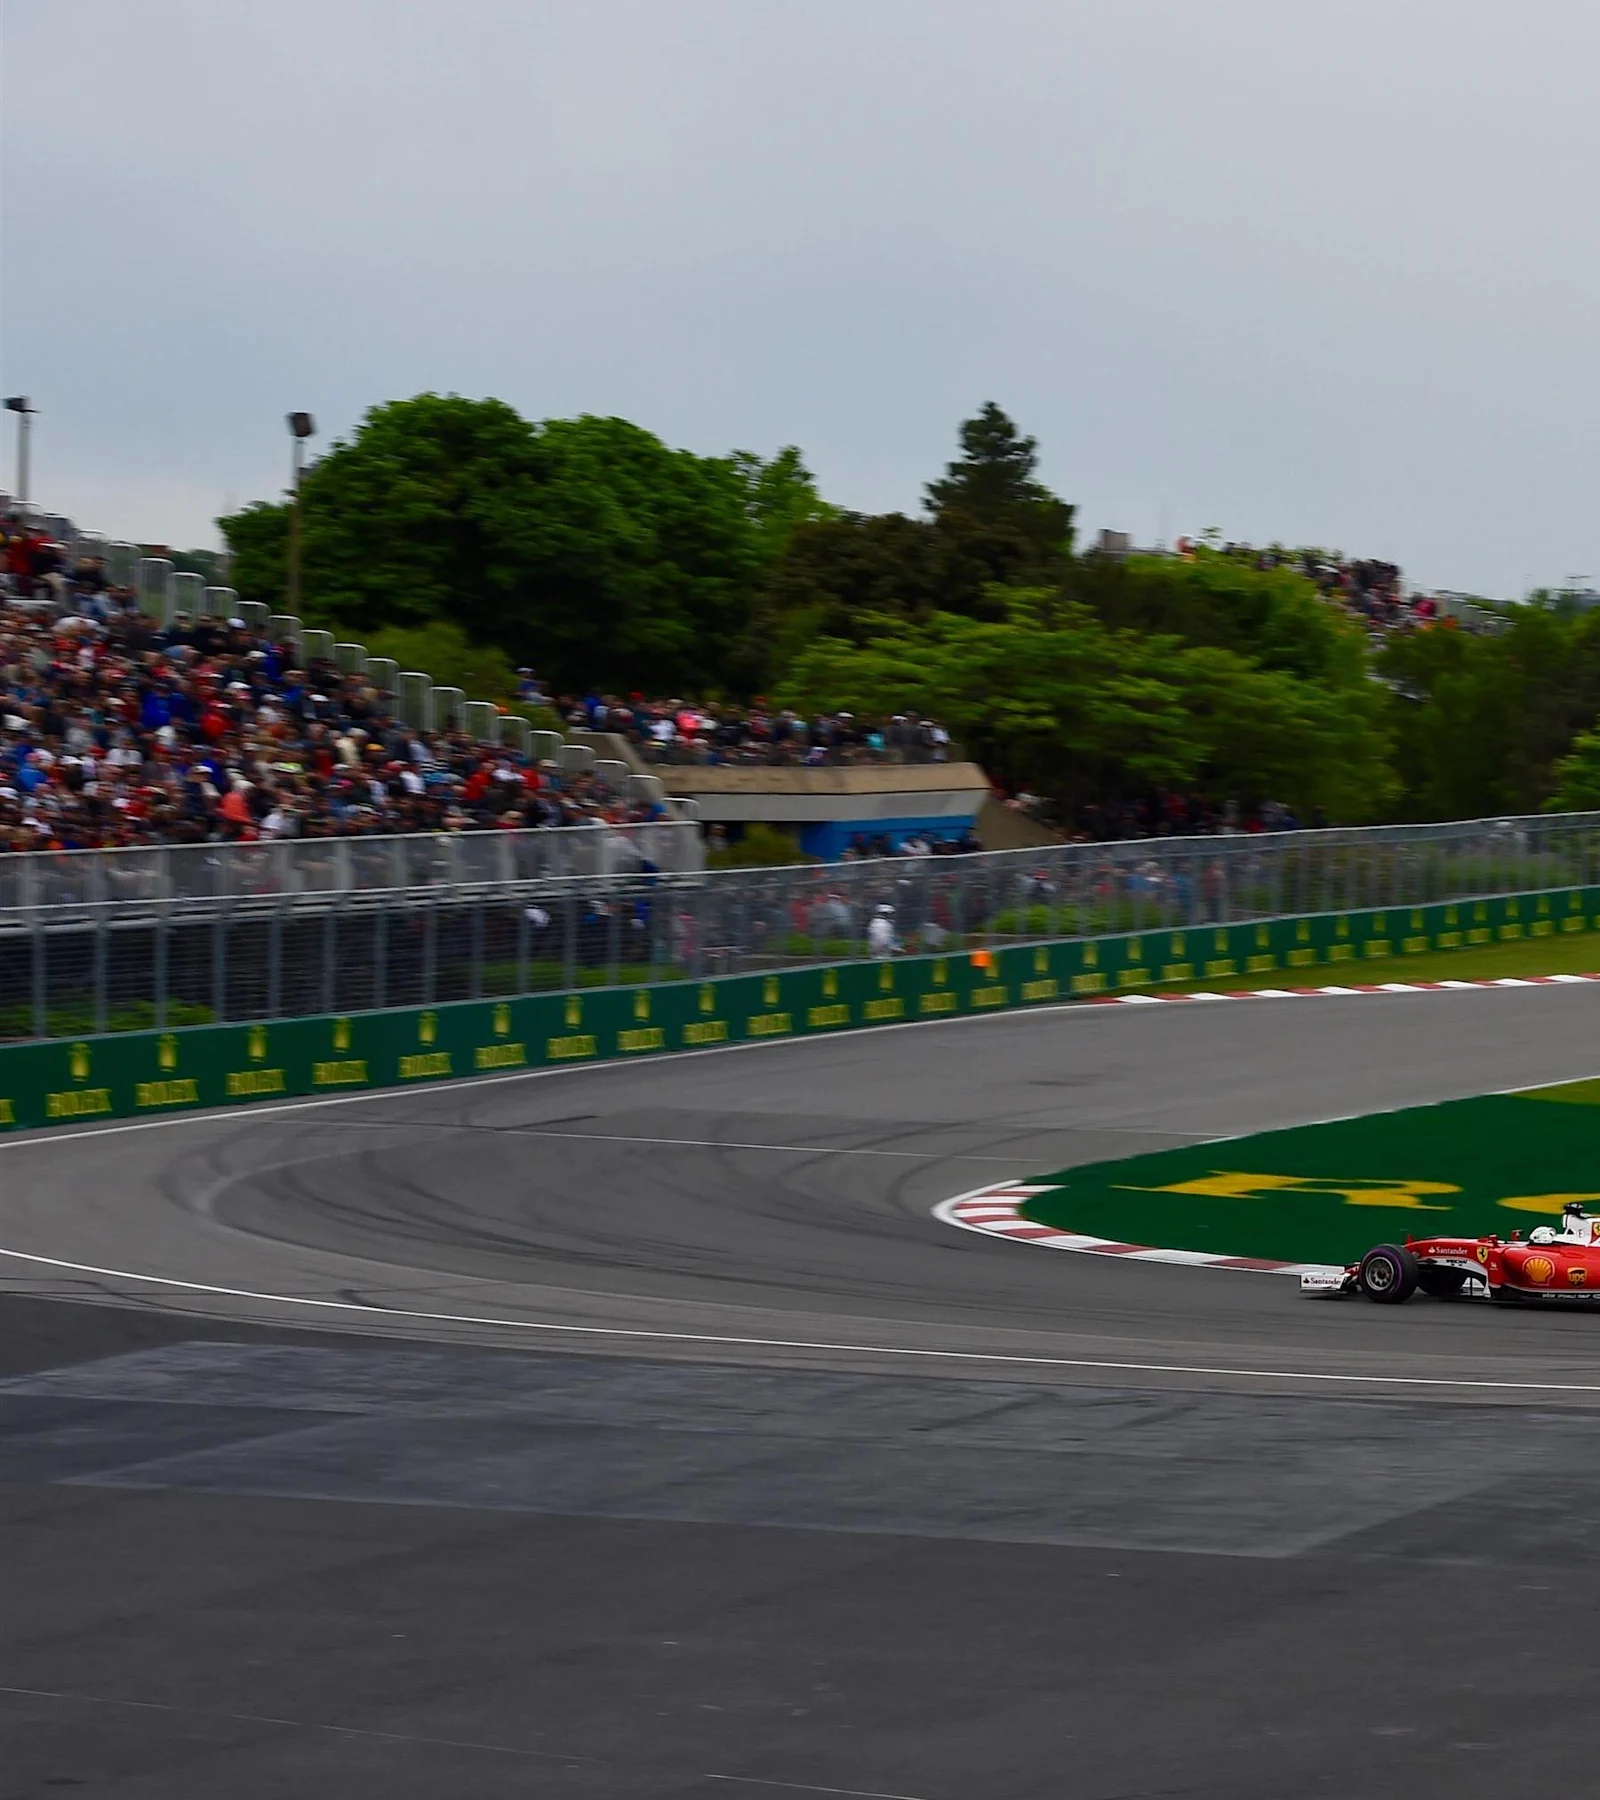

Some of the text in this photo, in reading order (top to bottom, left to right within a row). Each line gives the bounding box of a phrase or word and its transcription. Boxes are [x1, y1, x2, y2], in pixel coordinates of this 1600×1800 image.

[1435, 1246, 1468, 1255] Santander
[1310, 1277, 1341, 1285] Santander
[1569, 1273, 1586, 1285] ups
